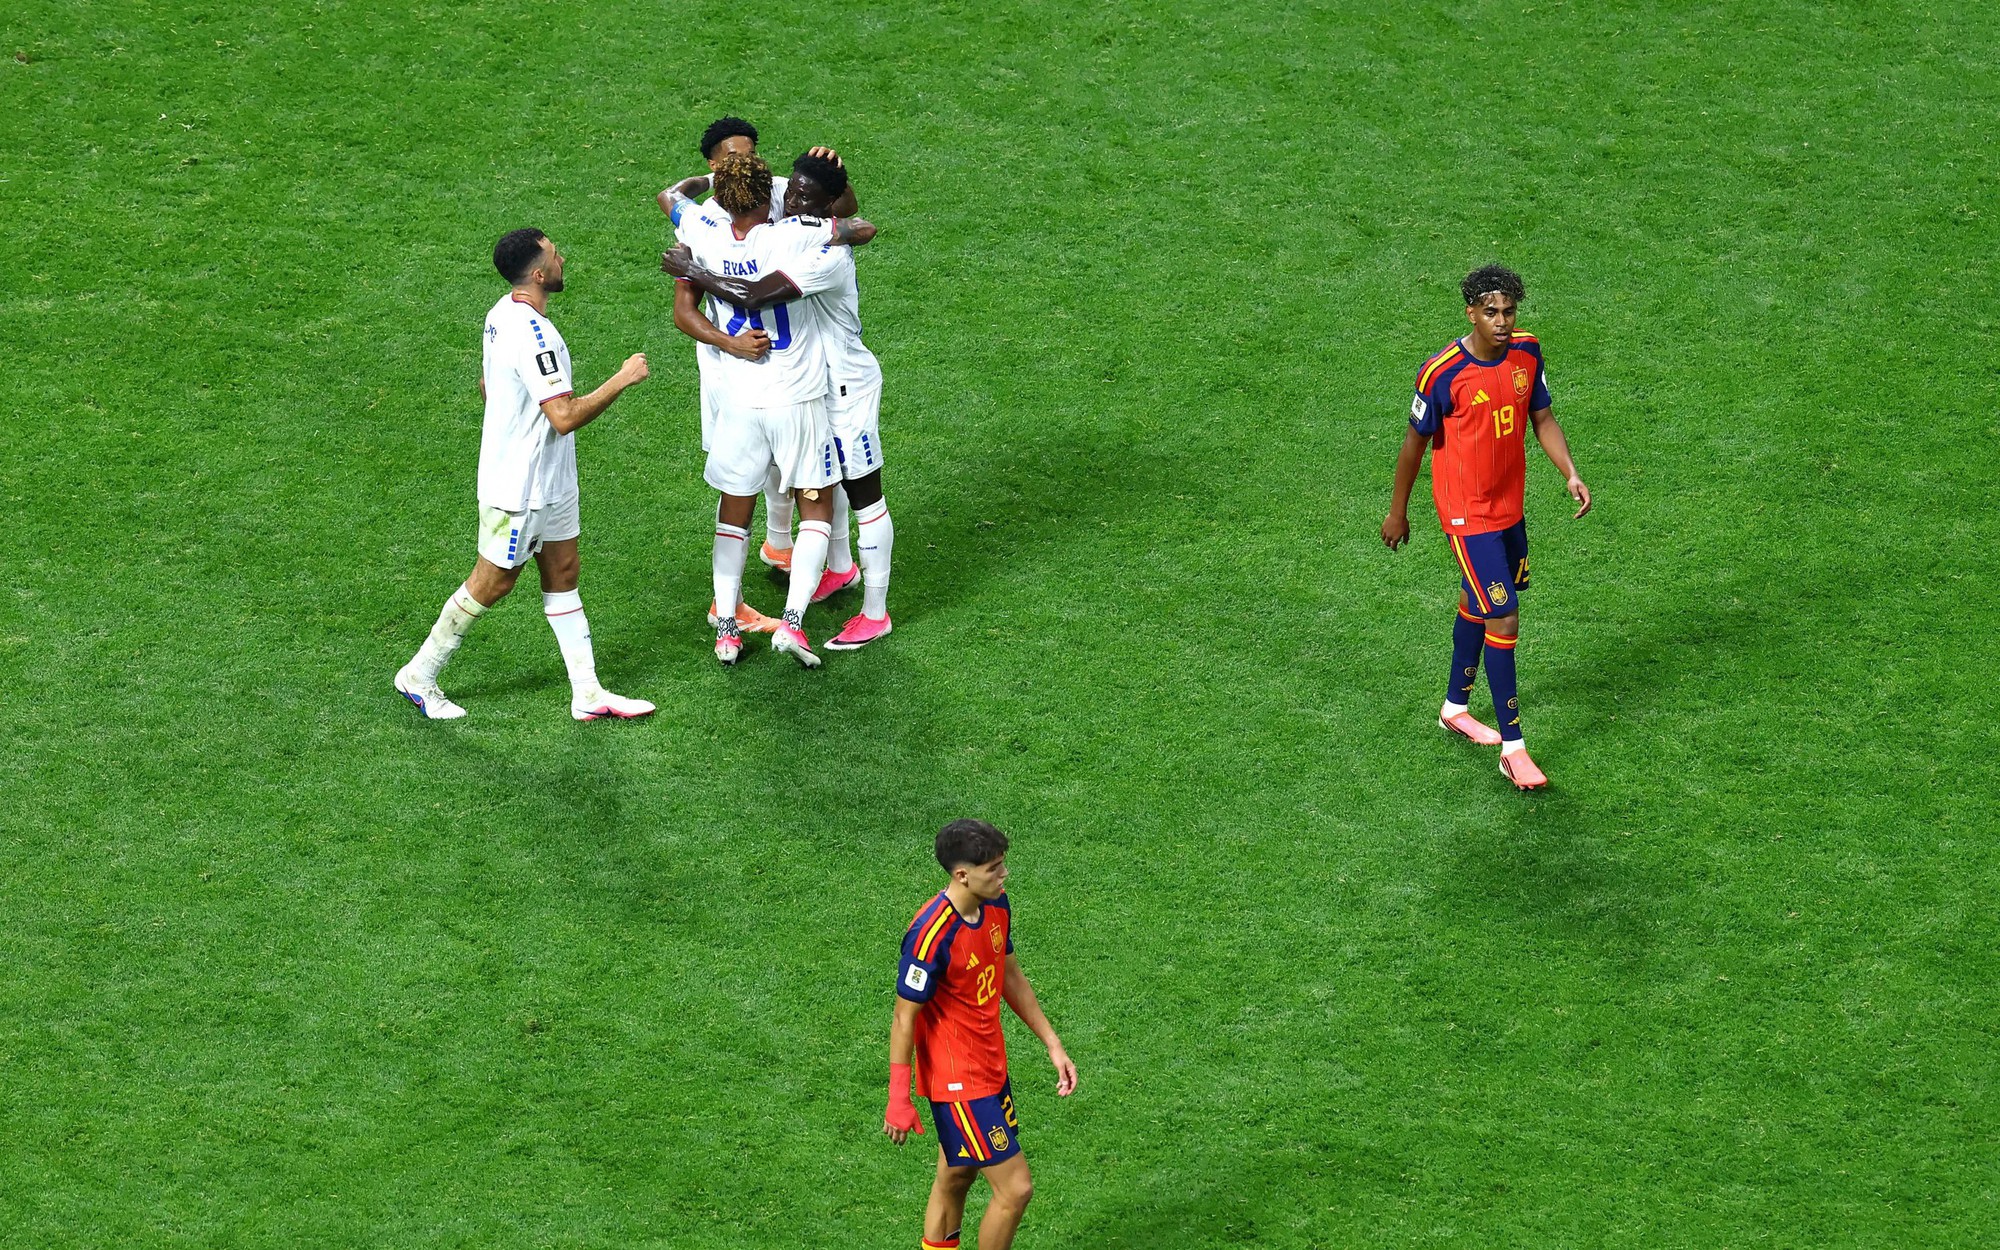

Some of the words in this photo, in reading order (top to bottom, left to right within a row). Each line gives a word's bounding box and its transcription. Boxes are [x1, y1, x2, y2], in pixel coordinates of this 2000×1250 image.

[723, 259, 758, 276] RYAN
[1492, 404, 1514, 439] 19
[976, 964, 997, 1006] 22
